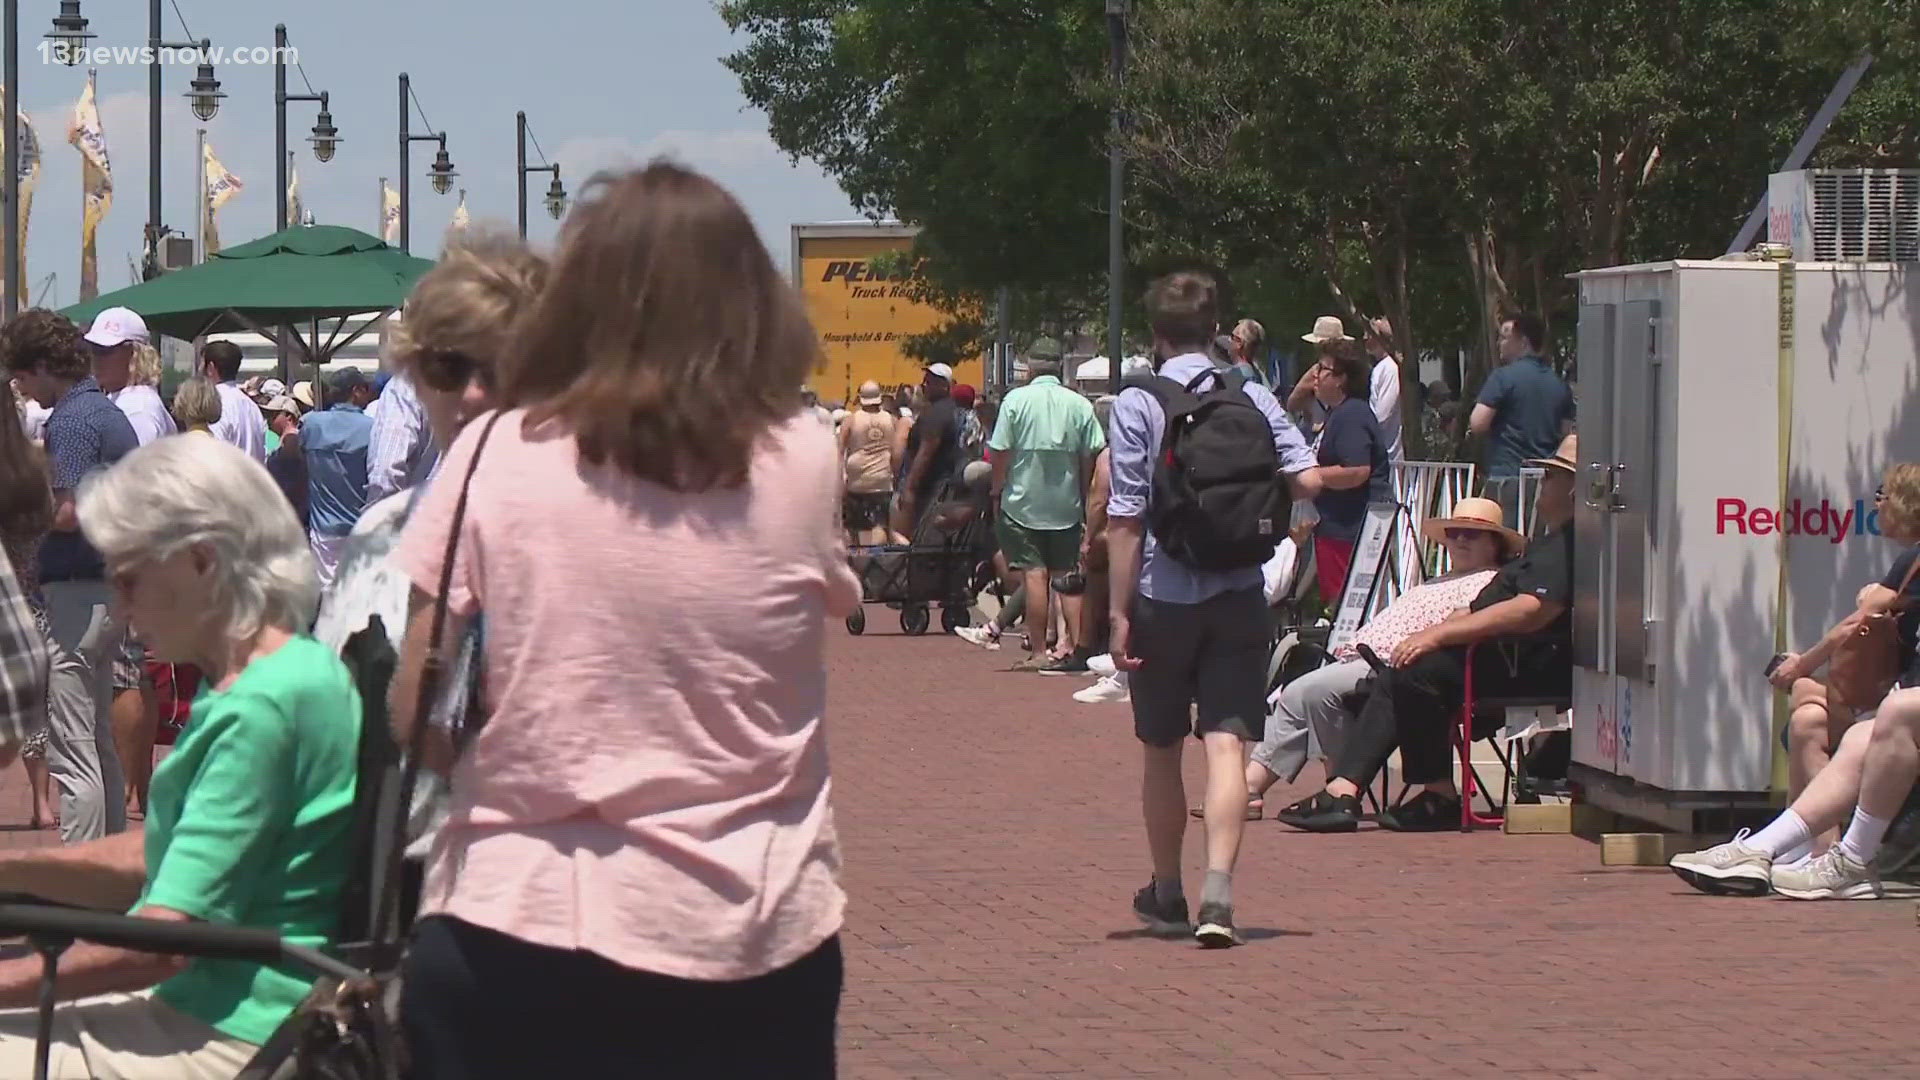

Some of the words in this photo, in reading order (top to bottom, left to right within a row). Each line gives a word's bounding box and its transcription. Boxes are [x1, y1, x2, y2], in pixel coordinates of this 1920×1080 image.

[851, 285, 887, 298] Truck
[823, 332, 872, 342] Household
[873, 332, 882, 341] &
[1716, 498, 1882, 544] ReddyIc
